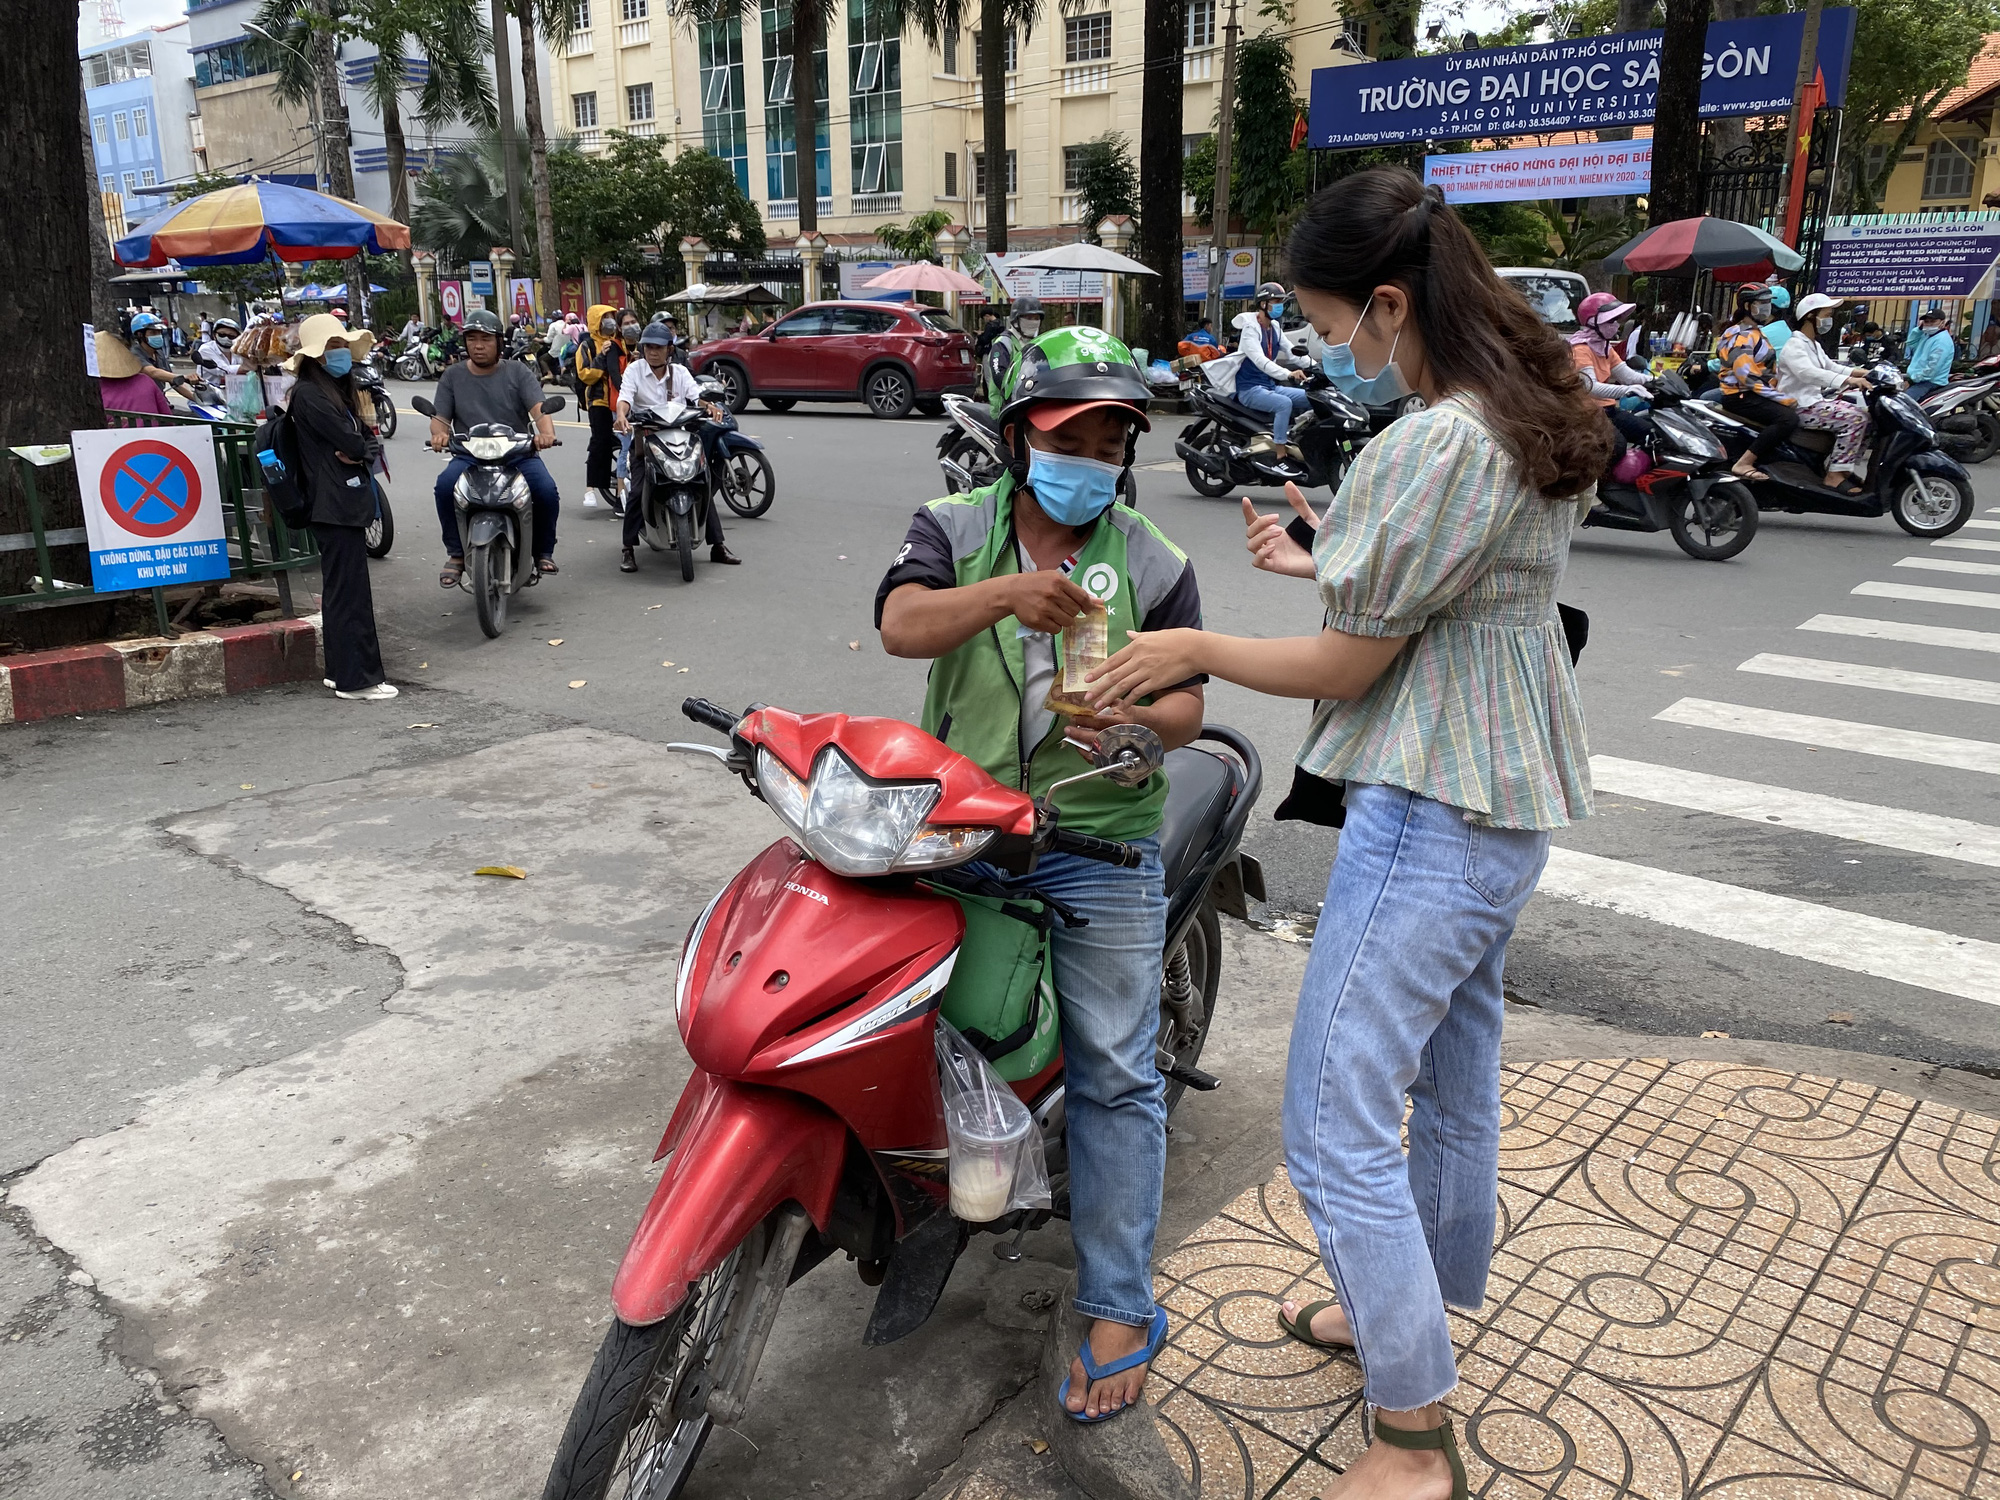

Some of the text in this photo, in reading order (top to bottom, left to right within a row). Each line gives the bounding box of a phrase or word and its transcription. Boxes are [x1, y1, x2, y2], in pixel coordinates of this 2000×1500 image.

[1446, 36, 1663, 72] ỦY BAN NHÂN DÂN TP.HỒ CHÍ MINH
[1358, 76, 1471, 114] TRƯỜNG
[1480, 71, 1531, 104] ĐẠI
[1540, 63, 1611, 98] HỌC
[1622, 50, 1661, 89] SÀ
[1440, 92, 1656, 122] SAIGON UNIVERSITY
[1328, 135, 1342, 144] 273
[1342, 134, 1353, 142] An
[1354, 131, 1378, 142] Dương
[1380, 130, 1405, 140] Vương
[1412, 128, 1423, 137] P.3
[1430, 126, 1444, 136] Q.5
[1451, 123, 1482, 134] TP.HCM
[1487, 121, 1500, 131] ĐT:
[1502, 119, 1527, 130] (84-8)
[1528, 115, 1571, 128] 38.354409
[1578, 114, 1597, 123] Fax:
[1600, 111, 1626, 122] (84-8)
[1628, 108, 1656, 120] 38.305
[1698, 104, 1720, 113] site:
[1722, 96, 1794, 112] www.sgu.edu.
[1431, 163, 1462, 178] NHIỆT
[1465, 162, 1487, 177] LIỆT
[1490, 159, 1520, 173] CHÀO
[1522, 158, 1556, 170] MỪNG
[1559, 157, 1579, 170] ĐẠI
[1582, 154, 1604, 169] HỘI
[1607, 153, 1628, 167] ĐẠI
[1518, 179, 1536, 188] MINH
[1616, 171, 1636, 182] 2020
[1642, 170, 1652, 180] 20
[1866, 227, 1902, 236] TRƯỜNG
[1904, 227, 1921, 236] ĐẠI
[1923, 226, 1944, 234] HỌC
[1963, 224, 1984, 232] GÒN
[100, 551, 128, 566] KHÔNG
[154, 546, 172, 562] ĐẬU
[172, 545, 189, 558] CÁC
[190, 544, 208, 558] LOẠI
[208, 544, 220, 555] XE
[136, 562, 188, 579] KHU VỰC NÀY
[784, 881, 830, 906] HONDA
